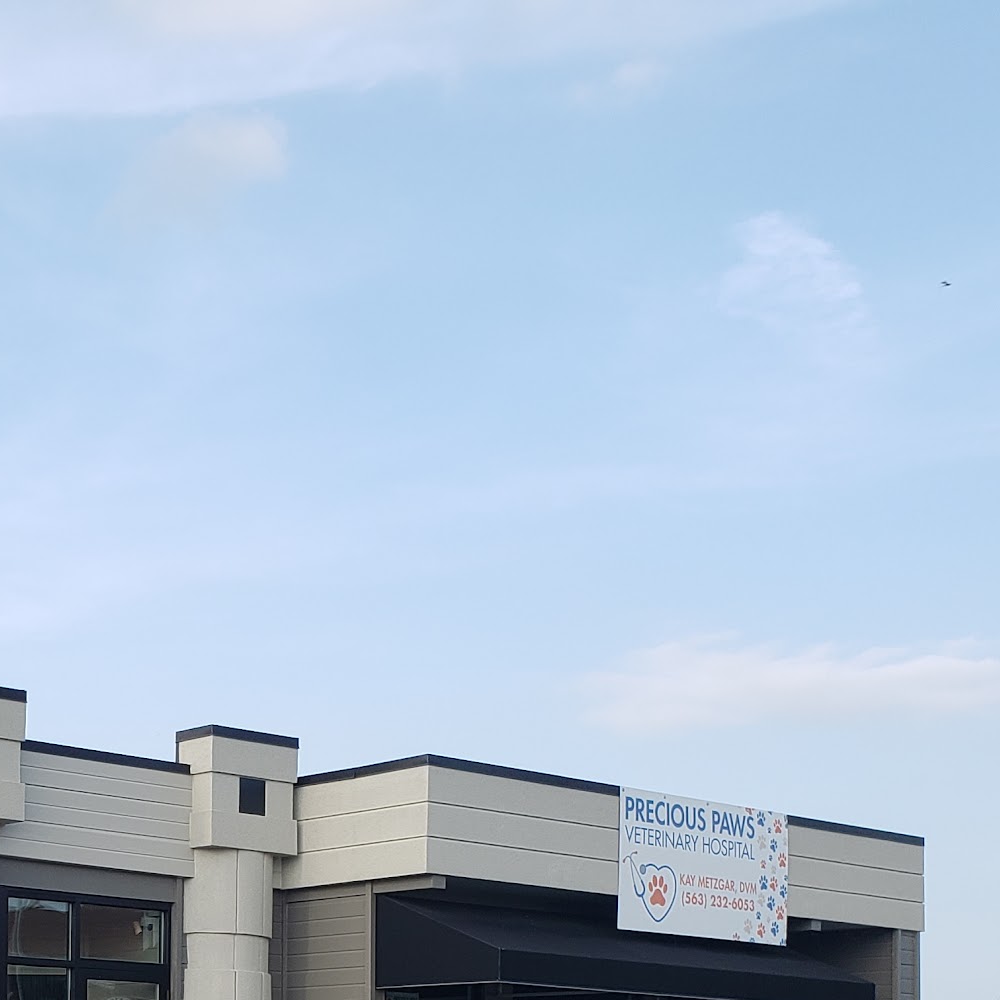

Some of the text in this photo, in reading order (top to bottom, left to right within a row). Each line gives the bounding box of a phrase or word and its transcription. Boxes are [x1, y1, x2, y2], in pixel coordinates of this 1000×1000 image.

[625, 796, 755, 839] PRECIOUS PAWS
[625, 825, 755, 861] VETERINARY HOSPITAL
[680, 873, 757, 895] KAY METZGAR, DVM
[682, 891, 755, 912] (563) 232-6053
